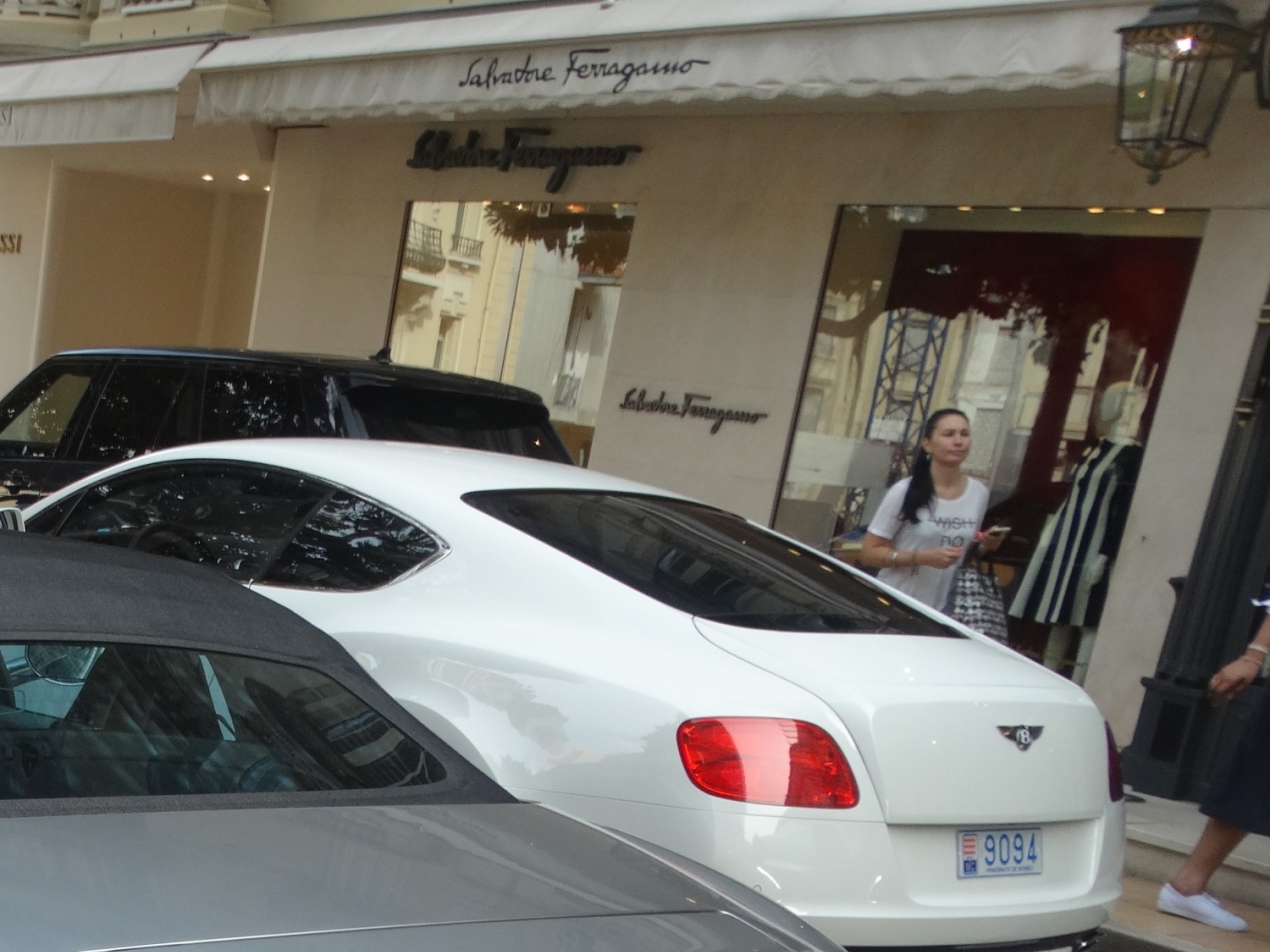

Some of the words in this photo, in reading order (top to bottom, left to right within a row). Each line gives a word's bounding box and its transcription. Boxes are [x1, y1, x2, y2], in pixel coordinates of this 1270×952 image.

[459, 54, 556, 90] Salvatore
[562, 48, 711, 94] Ferragamo
[619, 388, 681, 415] Salvatore
[681, 392, 768, 435] Ferragamo
[984, 832, 1038, 866] 9094
